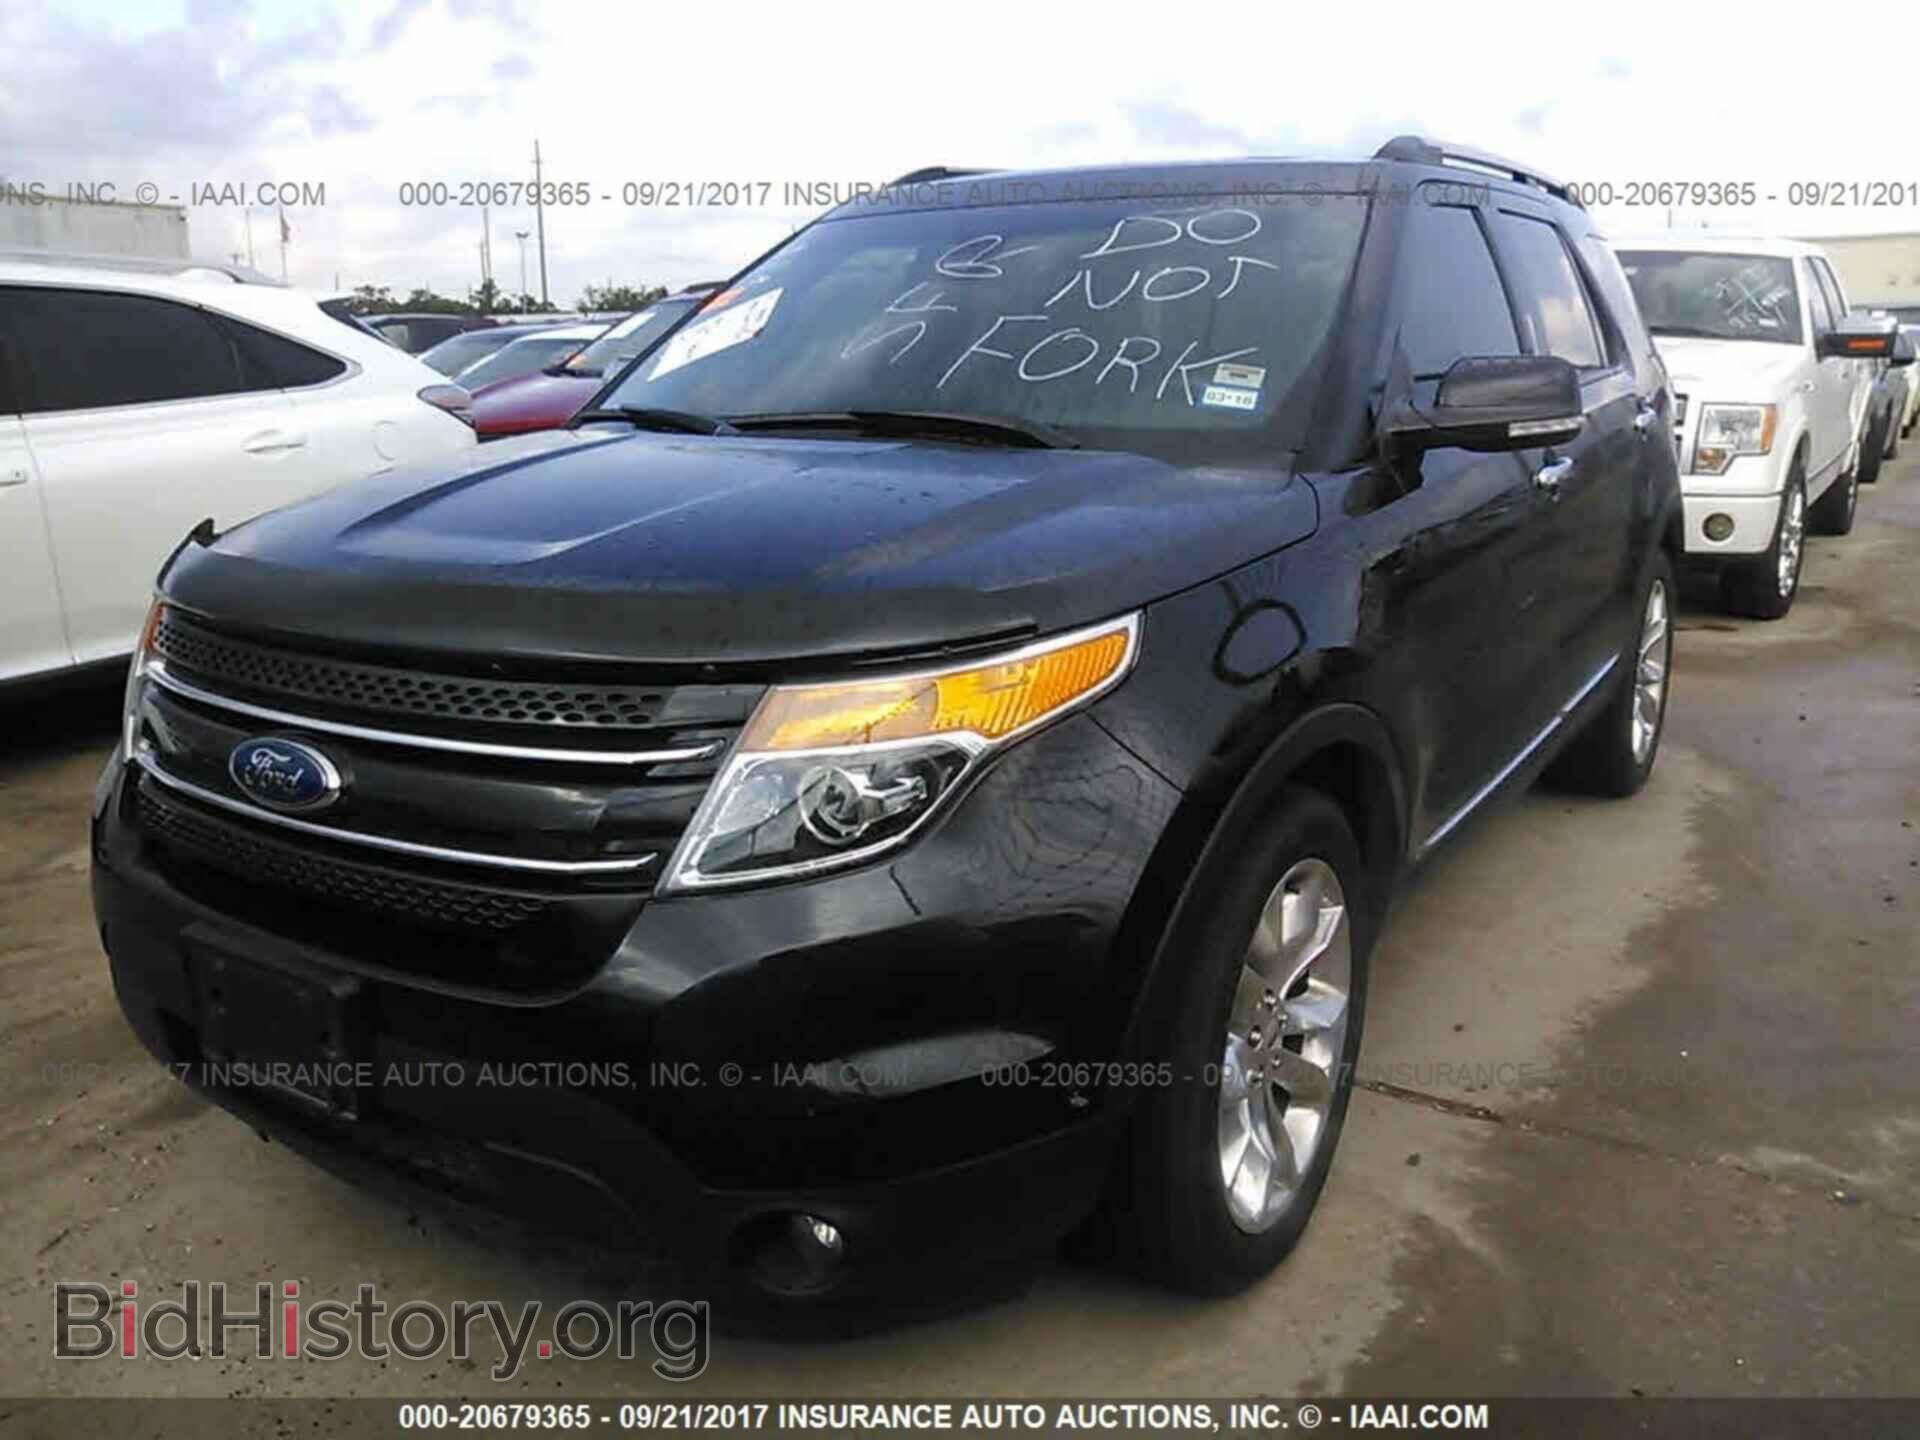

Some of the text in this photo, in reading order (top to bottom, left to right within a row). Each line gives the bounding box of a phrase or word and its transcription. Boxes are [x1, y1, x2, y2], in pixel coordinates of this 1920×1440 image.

[1080, 209, 1261, 260] DO
[1045, 256, 1278, 310] NOT
[936, 315, 1260, 407] FORK
[244, 747, 306, 792] Ford
